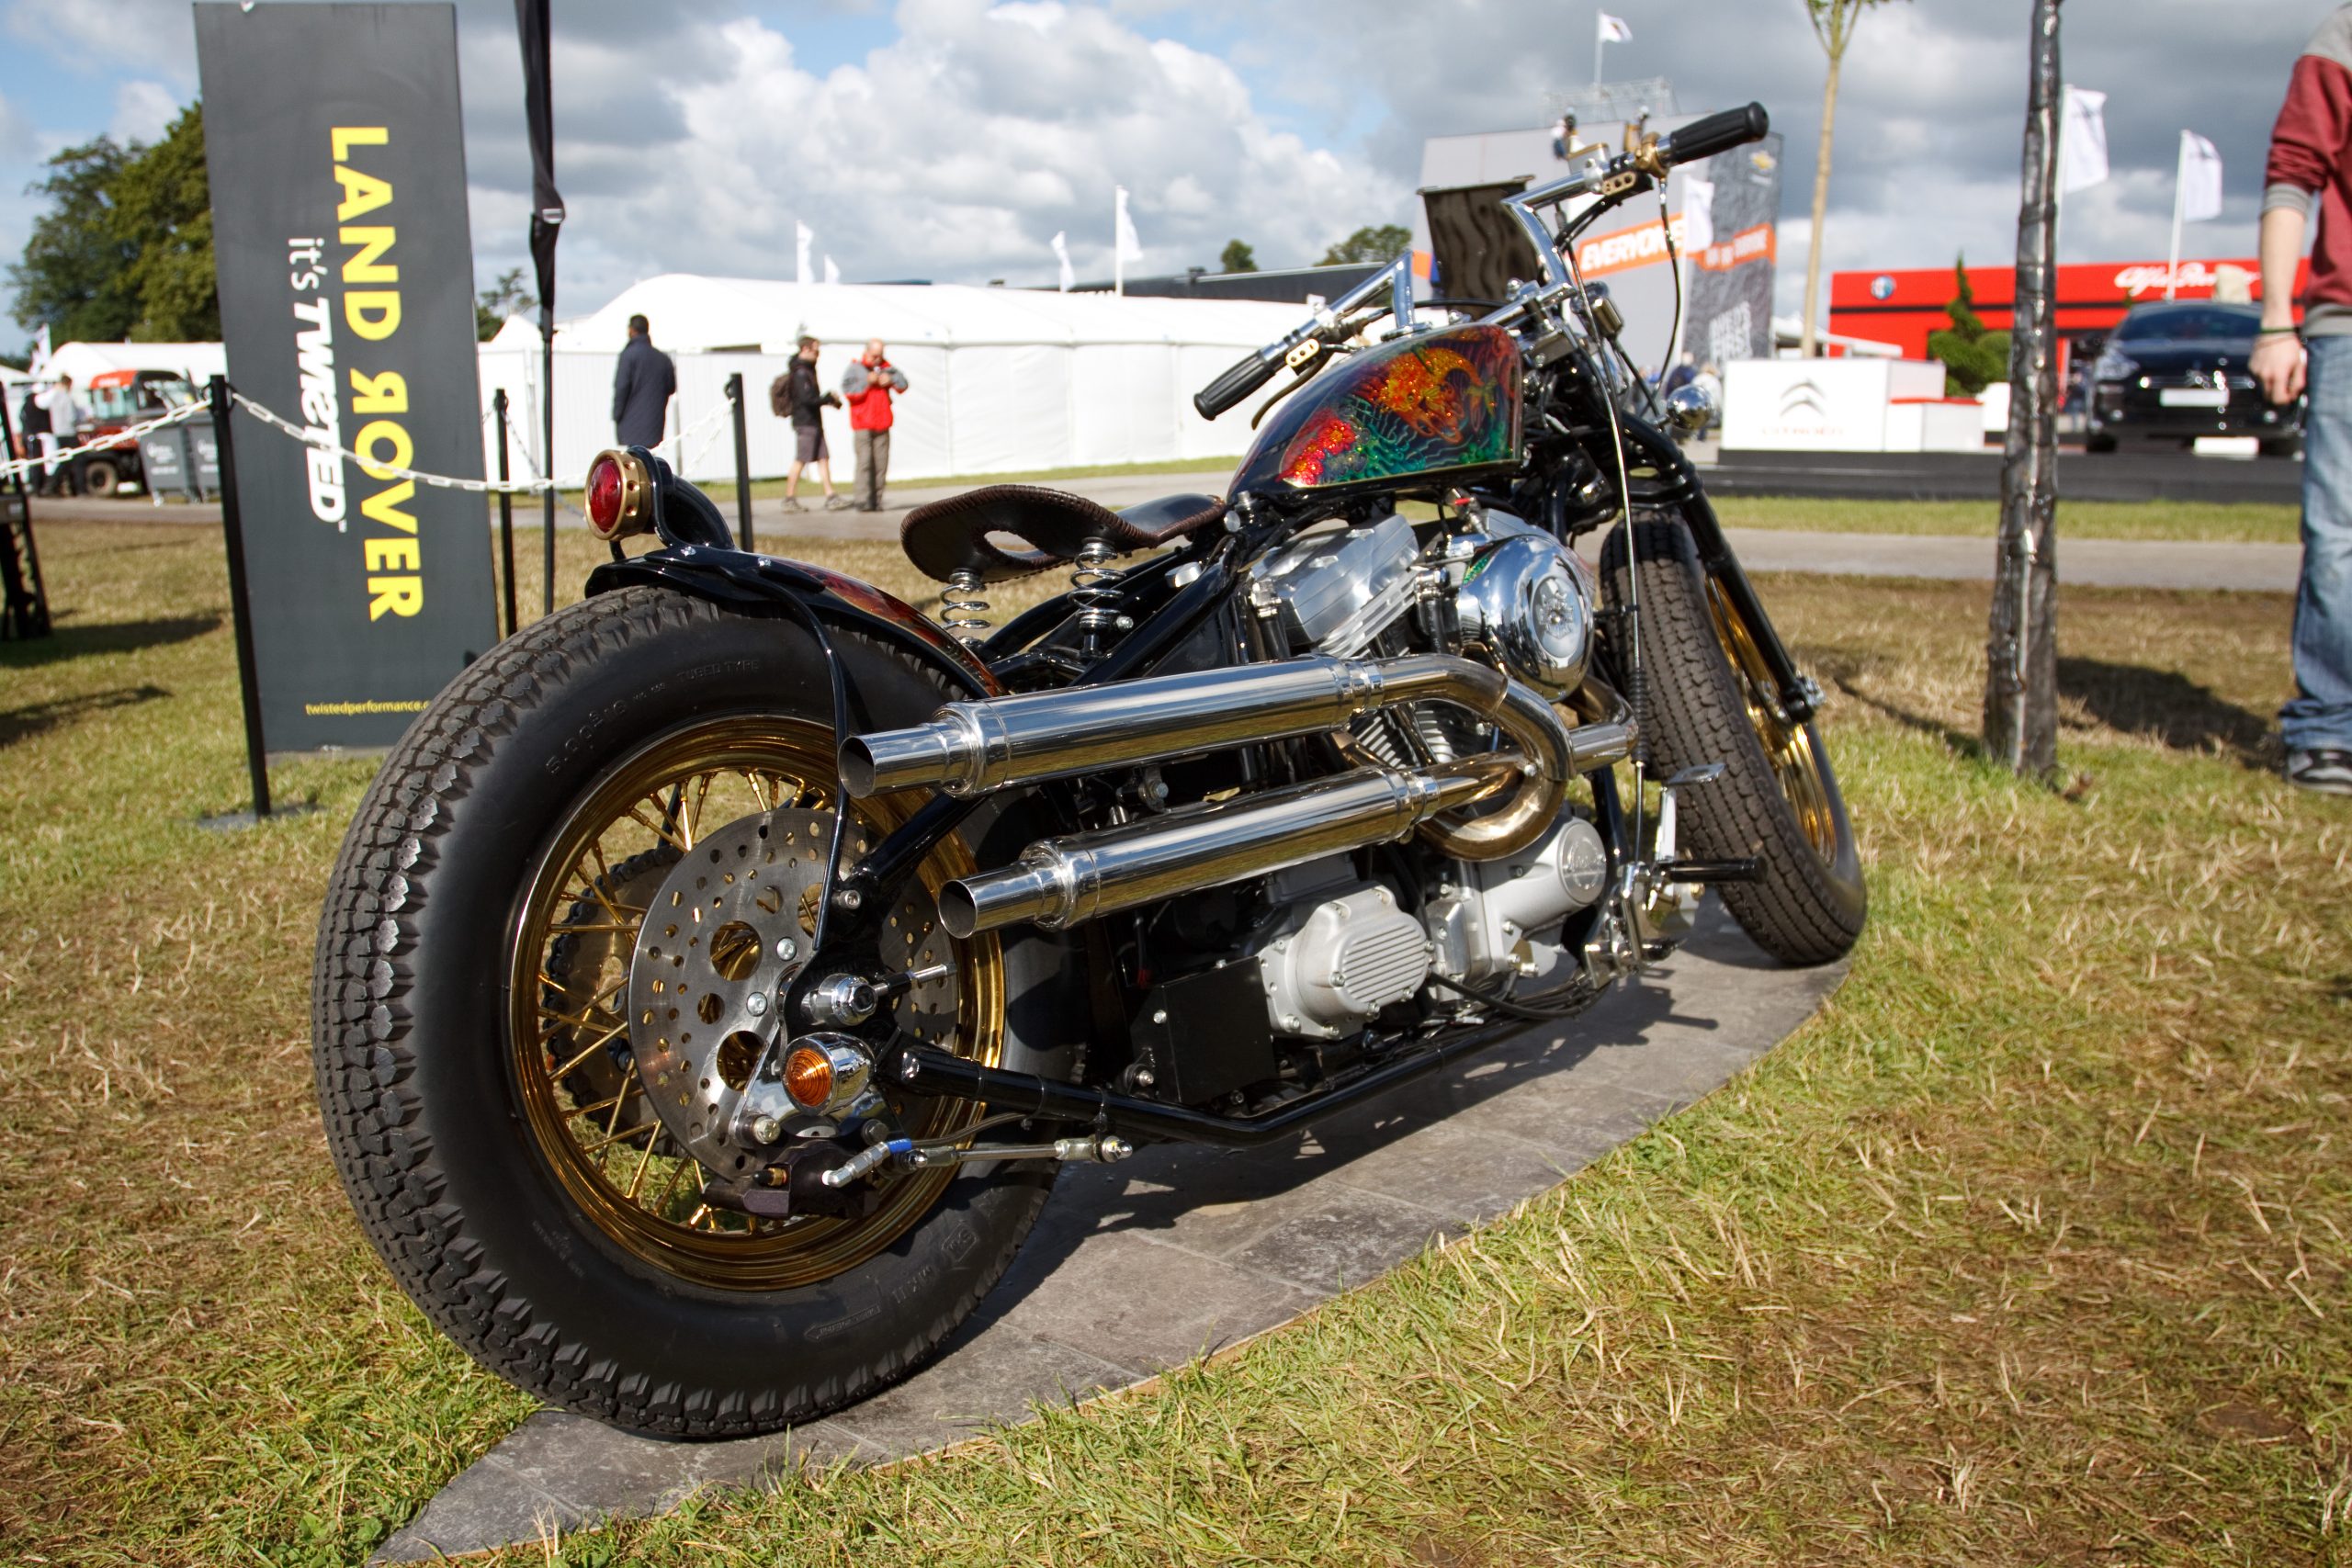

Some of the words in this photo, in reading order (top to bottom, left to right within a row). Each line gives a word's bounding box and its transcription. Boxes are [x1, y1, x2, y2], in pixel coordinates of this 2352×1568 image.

[288, 237, 329, 291] it's
[331, 127, 402, 341] LAND
[294, 297, 347, 524] TWISTED
